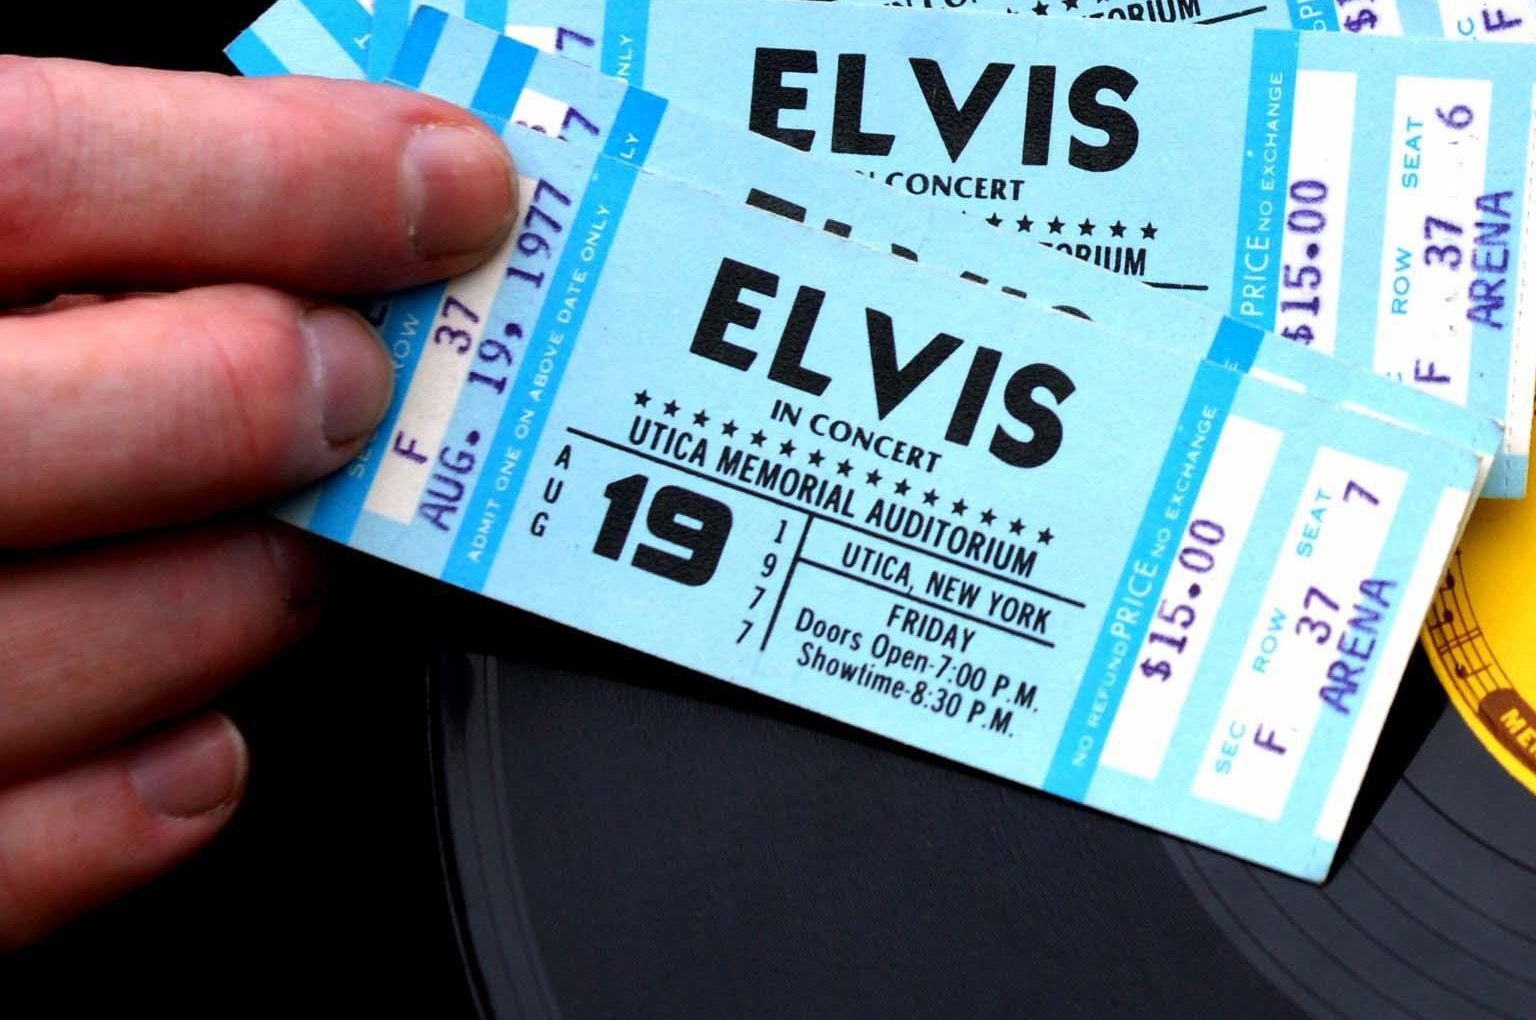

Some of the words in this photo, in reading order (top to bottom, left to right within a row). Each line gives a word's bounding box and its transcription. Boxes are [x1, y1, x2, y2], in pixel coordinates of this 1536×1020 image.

[617, 35, 632, 79] NLY
[1483, 9, 1524, 35] F
[748, 46, 1139, 173] ELVIS
[1262, 72, 1283, 191] EXCHANGE
[1436, 104, 1473, 130] 6
[1402, 115, 1424, 188] SEAT
[1258, 200, 1273, 231] NO
[1424, 216, 1462, 269] 37
[1240, 235, 1270, 317] PRICE
[1391, 247, 1413, 314] ROW
[1467, 190, 1513, 330] ARENA
[392, 430, 428, 465] F
[434, 295, 479, 355] 37
[419, 430, 480, 532] AUG.
[468, 323, 523, 395] 19,
[507, 178, 571, 289] 1977
[467, 498, 499, 564] ADMIT
[495, 447, 521, 492] ONE
[514, 409, 535, 440] ON
[528, 332, 564, 402] ABOVE
[557, 269, 587, 324] DATE
[580, 203, 610, 261] ONLY
[690, 256, 1077, 469] ELVIS
[1414, 358, 1451, 384] F
[771, 399, 803, 427] IN
[809, 413, 942, 473] CONCERT
[593, 474, 733, 587] 19
[628, 415, 706, 467] UTICA
[716, 446, 857, 519] MEMORIAL
[864, 498, 1038, 579] AUDITORIUM
[1296, 488, 1332, 559] SEAT
[1342, 479, 1381, 508] 7
[841, 542, 914, 593] UTICA,
[925, 570, 982, 611] NEW
[987, 592, 1052, 635] YORK
[1071, 736, 1093, 767] NO
[1087, 640, 1128, 728] REFUND
[1113, 560, 1159, 638] PRICE
[1150, 527, 1172, 559] NO
[1165, 404, 1219, 522] EXCHANGE
[1296, 585, 1341, 645] 37
[794, 607, 863, 650] Doors
[870, 633, 987, 693] Open-7:00
[992, 676, 1040, 713] P.M.
[886, 604, 977, 654] FRIDAY
[1252, 607, 1287, 674] ROW
[1317, 577, 1399, 716] ARENA
[797, 642, 963, 718] Showtime-8:30
[967, 700, 1015, 738] P.M.
[1215, 720, 1247, 775] SEC
[1254, 722, 1288, 756] F
